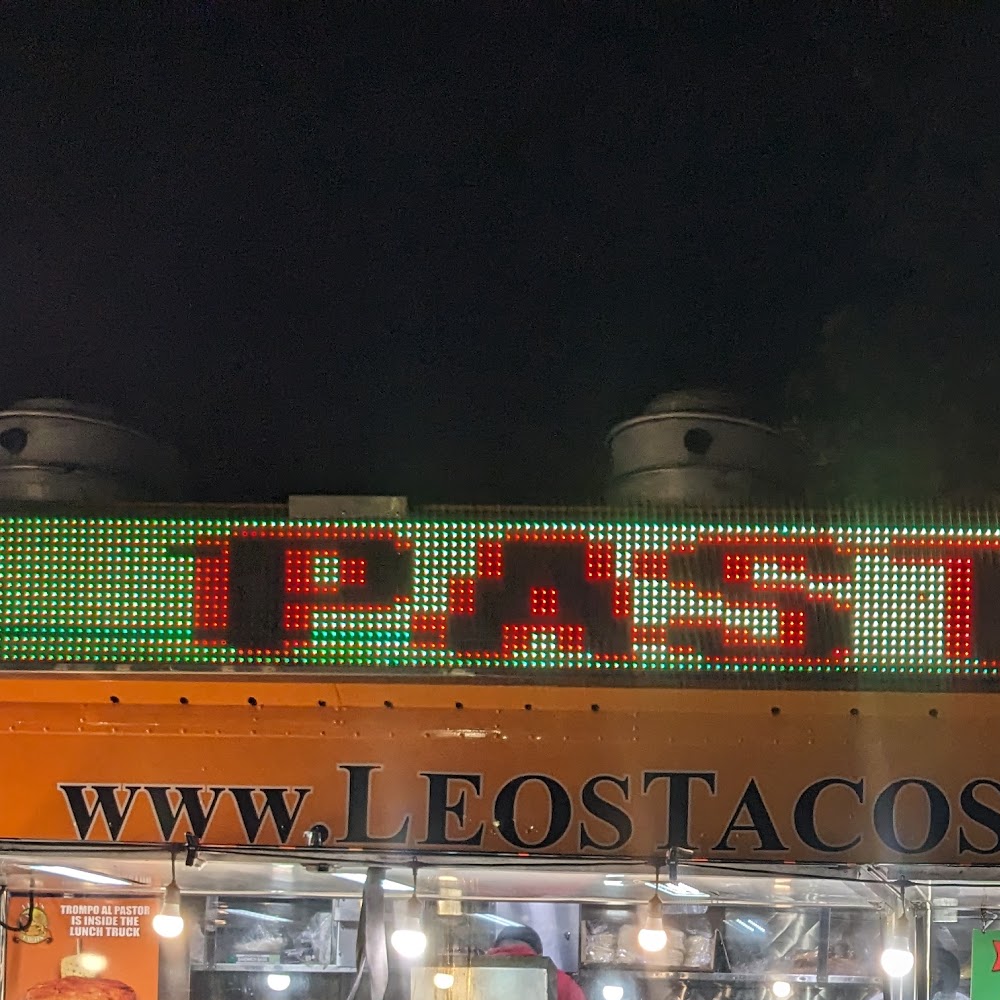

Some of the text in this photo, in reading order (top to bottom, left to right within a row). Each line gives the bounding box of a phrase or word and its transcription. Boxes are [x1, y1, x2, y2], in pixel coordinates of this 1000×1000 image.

[61, 905, 150, 915] TROMPO AL PASTOR
[71, 916, 139, 926] IS INSIDE THE
[70, 927, 140, 937] LUNCH TRUCK
